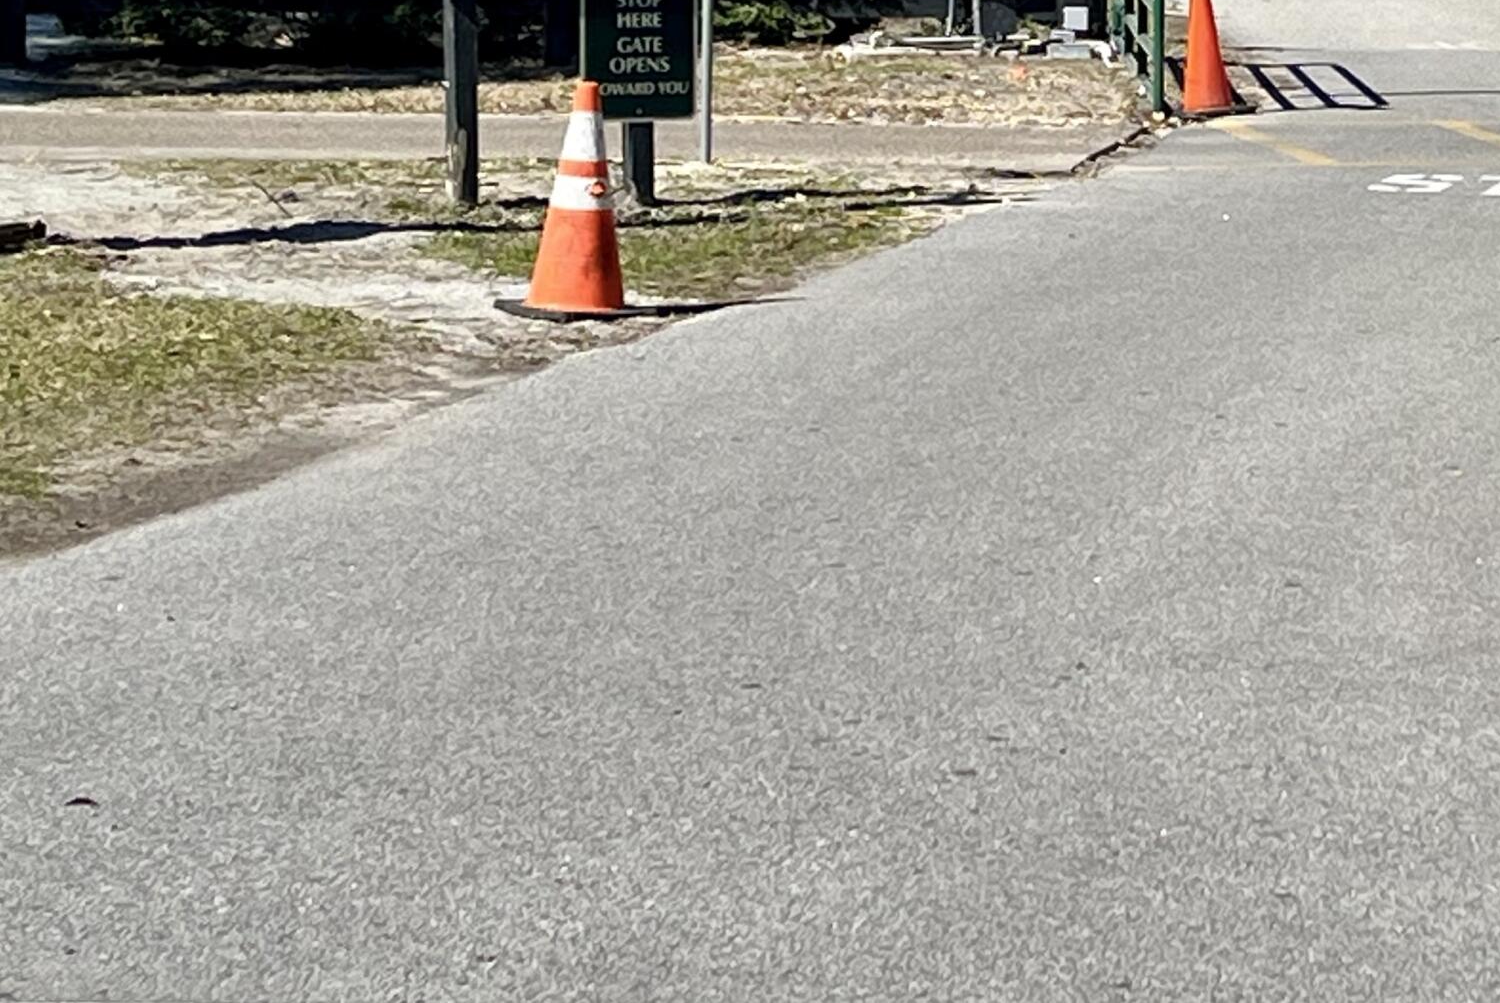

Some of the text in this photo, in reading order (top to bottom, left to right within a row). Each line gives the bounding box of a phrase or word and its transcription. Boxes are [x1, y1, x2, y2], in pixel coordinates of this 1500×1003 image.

[616, 11, 663, 29] HERE
[616, 36, 663, 53] GATE
[608, 55, 671, 74] OPENS
[598, 80, 690, 96] OWARD YOU
